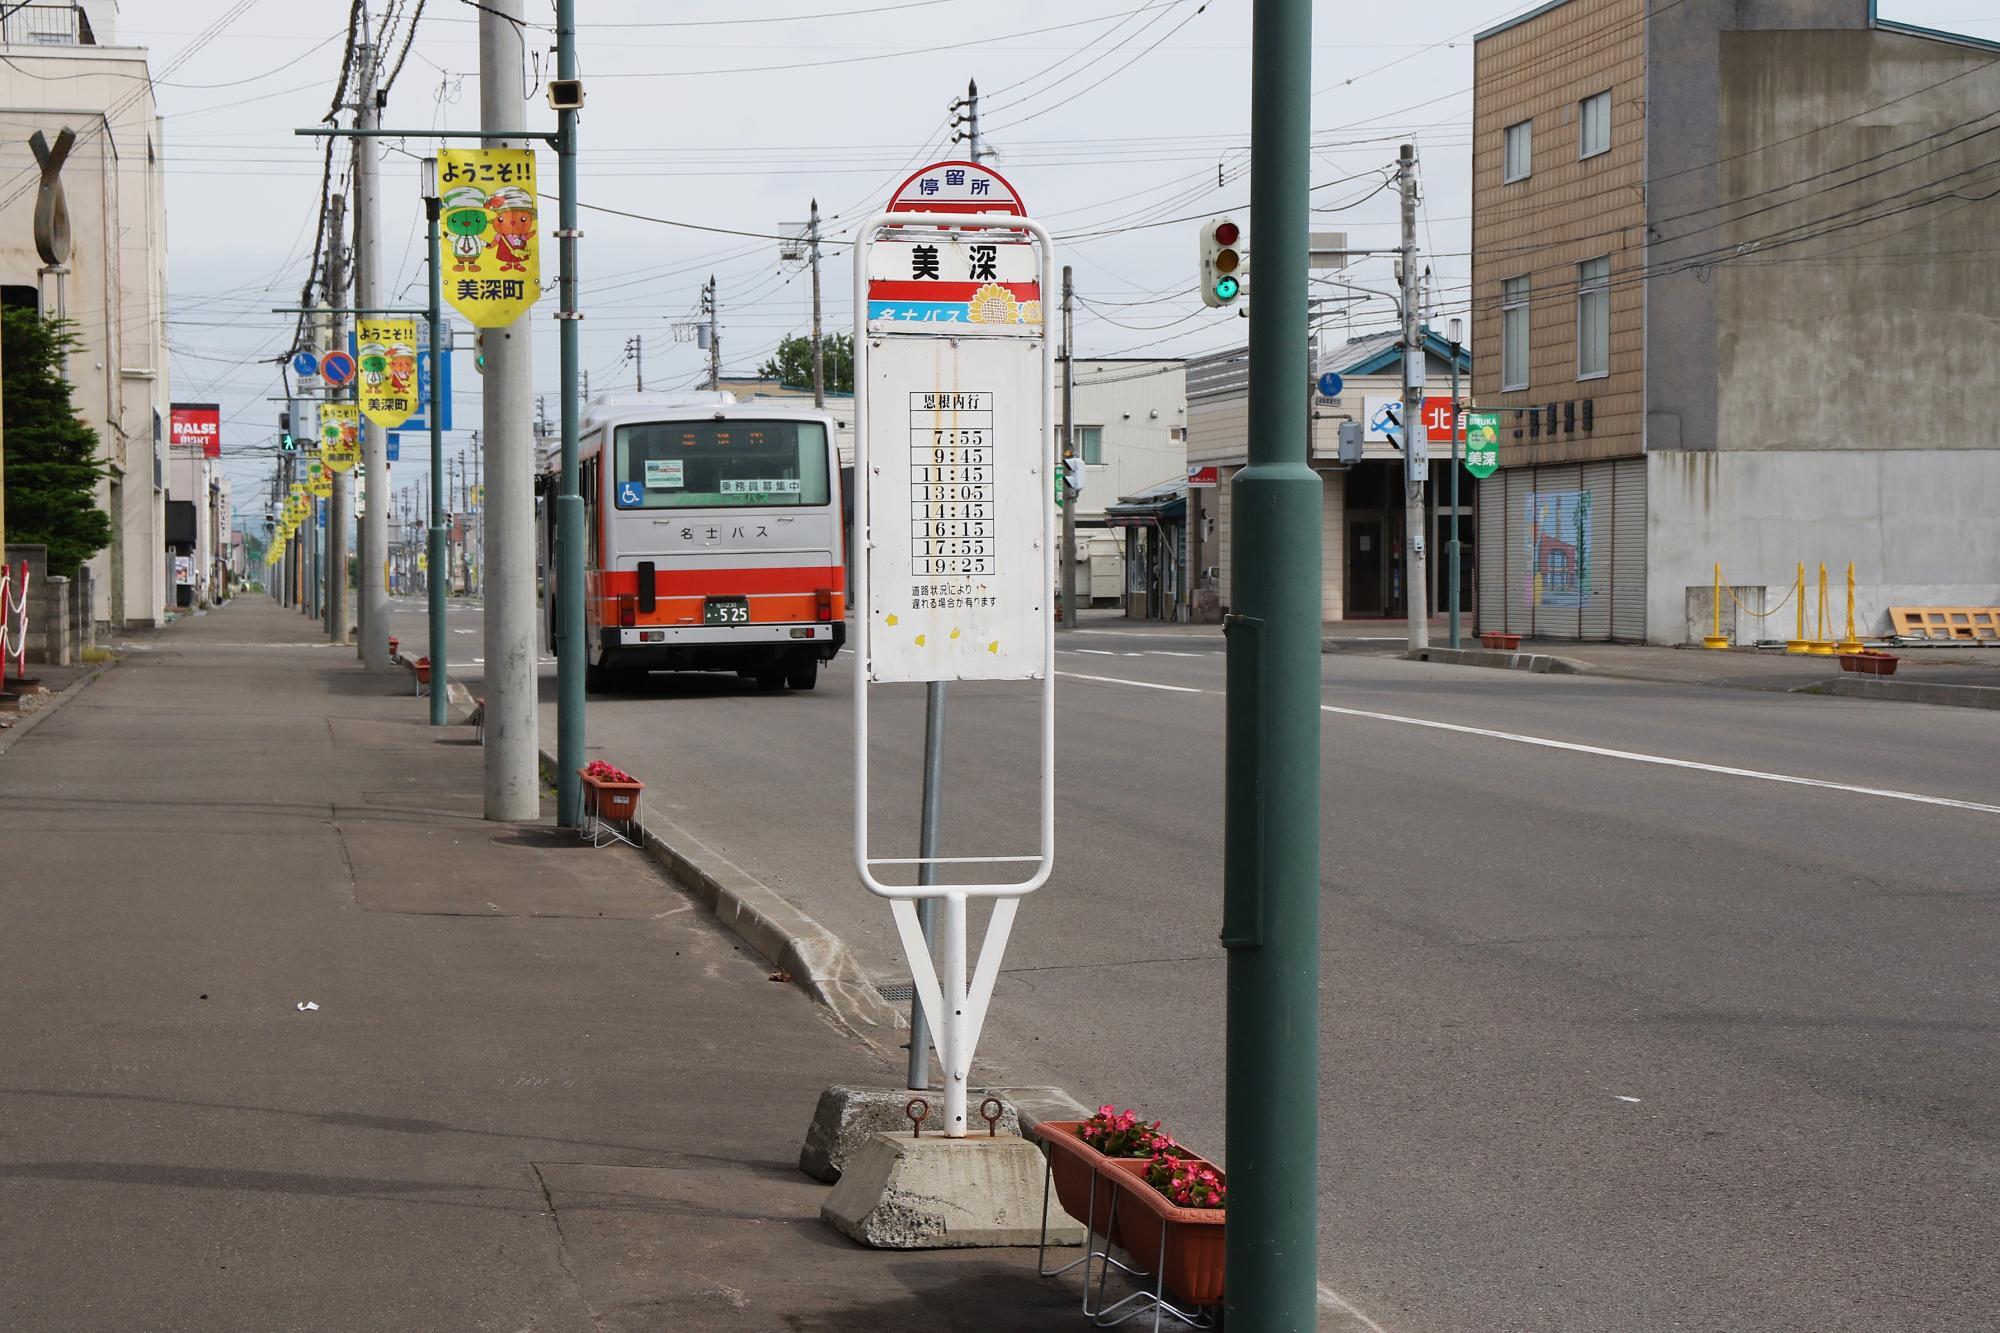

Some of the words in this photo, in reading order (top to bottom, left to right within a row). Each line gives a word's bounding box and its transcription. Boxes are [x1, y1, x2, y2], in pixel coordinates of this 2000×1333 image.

[442, 162, 531, 182] ようこそ!!
[919, 169, 990, 195] 停留所
[911, 244, 997, 281] 美深
[457, 279, 525, 300] 美深町
[368, 398, 409, 412] 美深町
[923, 394, 980, 409] 恩根内行
[173, 422, 217, 435] RALSE
[934, 431, 983, 445] 7:55
[934, 448, 983, 464] 9:45
[1468, 452, 1496, 466] 美深
[923, 467, 983, 482] 11:45
[721, 481, 800, 492] 乗務員募集中
[923, 485, 983, 500] 13:05
[923, 503, 983, 518] 14:45
[681, 526, 768, 540] 名士バス
[924, 522, 985, 537] 16:15
[924, 540, 985, 555] 17:55
[924, 558, 985, 574] 19:25
[912, 584, 972, 597] 道路状況により
[912, 597, 997, 609] 遅れる場合が有ります
